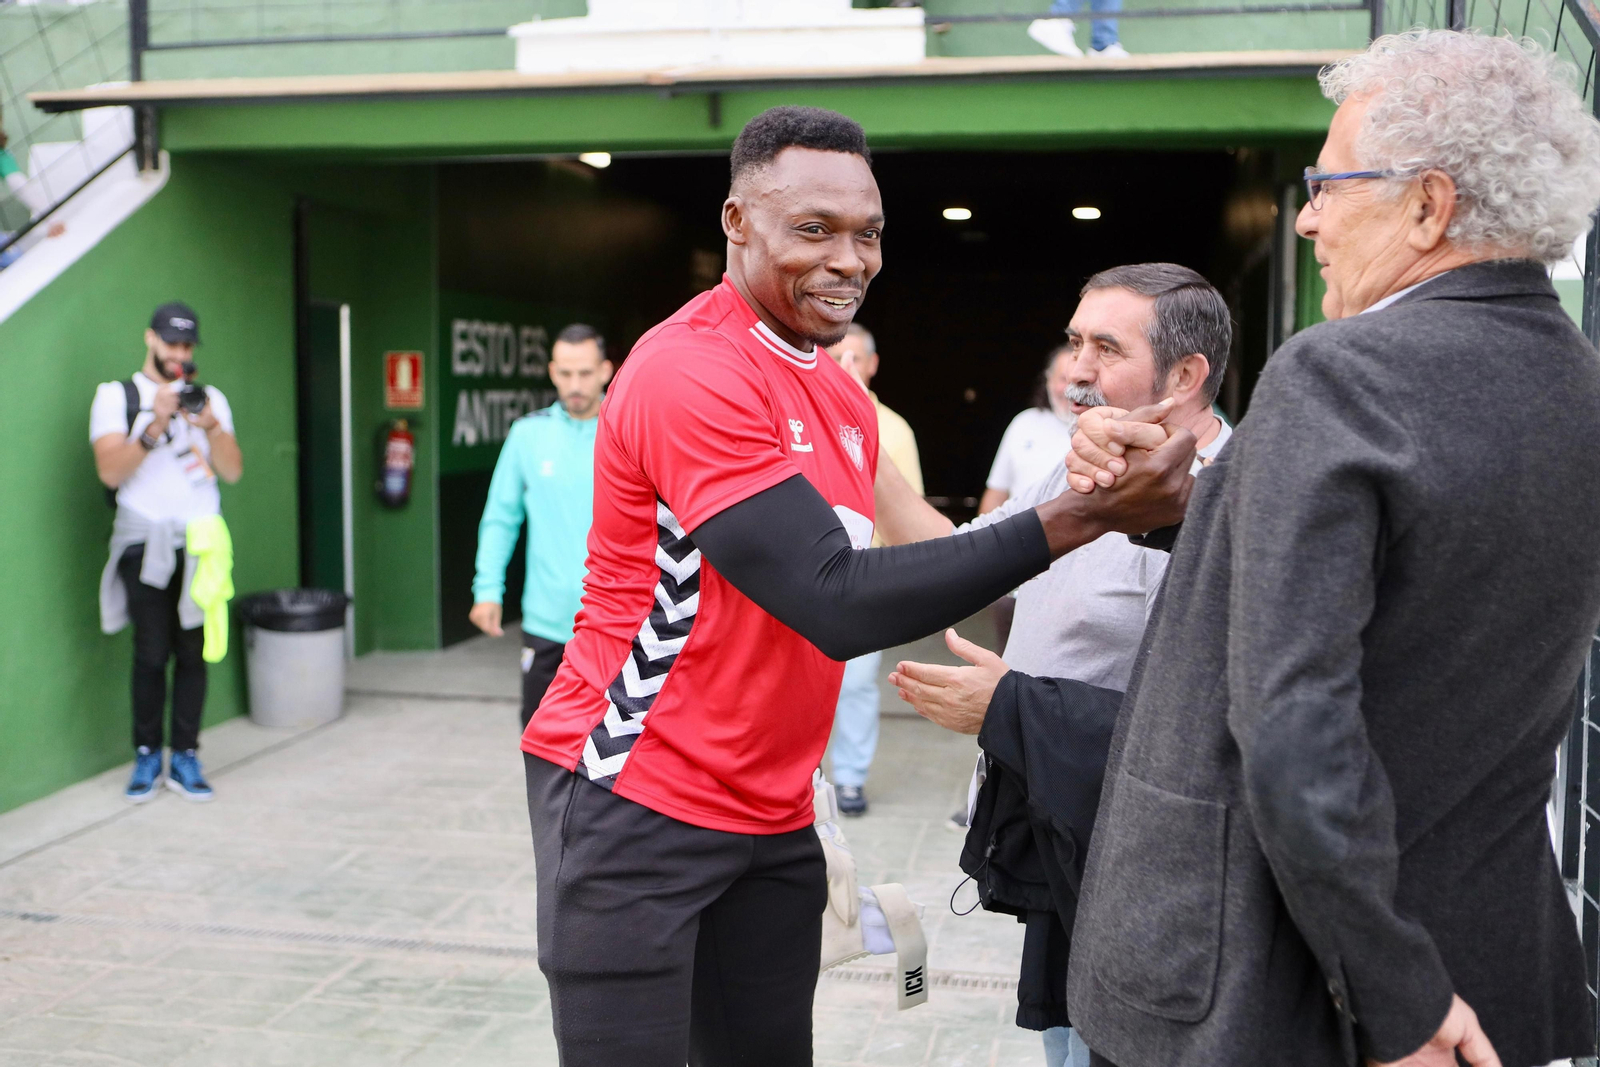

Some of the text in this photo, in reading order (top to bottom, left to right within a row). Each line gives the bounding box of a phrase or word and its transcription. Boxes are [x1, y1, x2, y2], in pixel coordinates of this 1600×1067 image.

[452, 319, 549, 377] ESTO ES
[453, 389, 558, 447] ANTE
[905, 965, 923, 997] ICK
